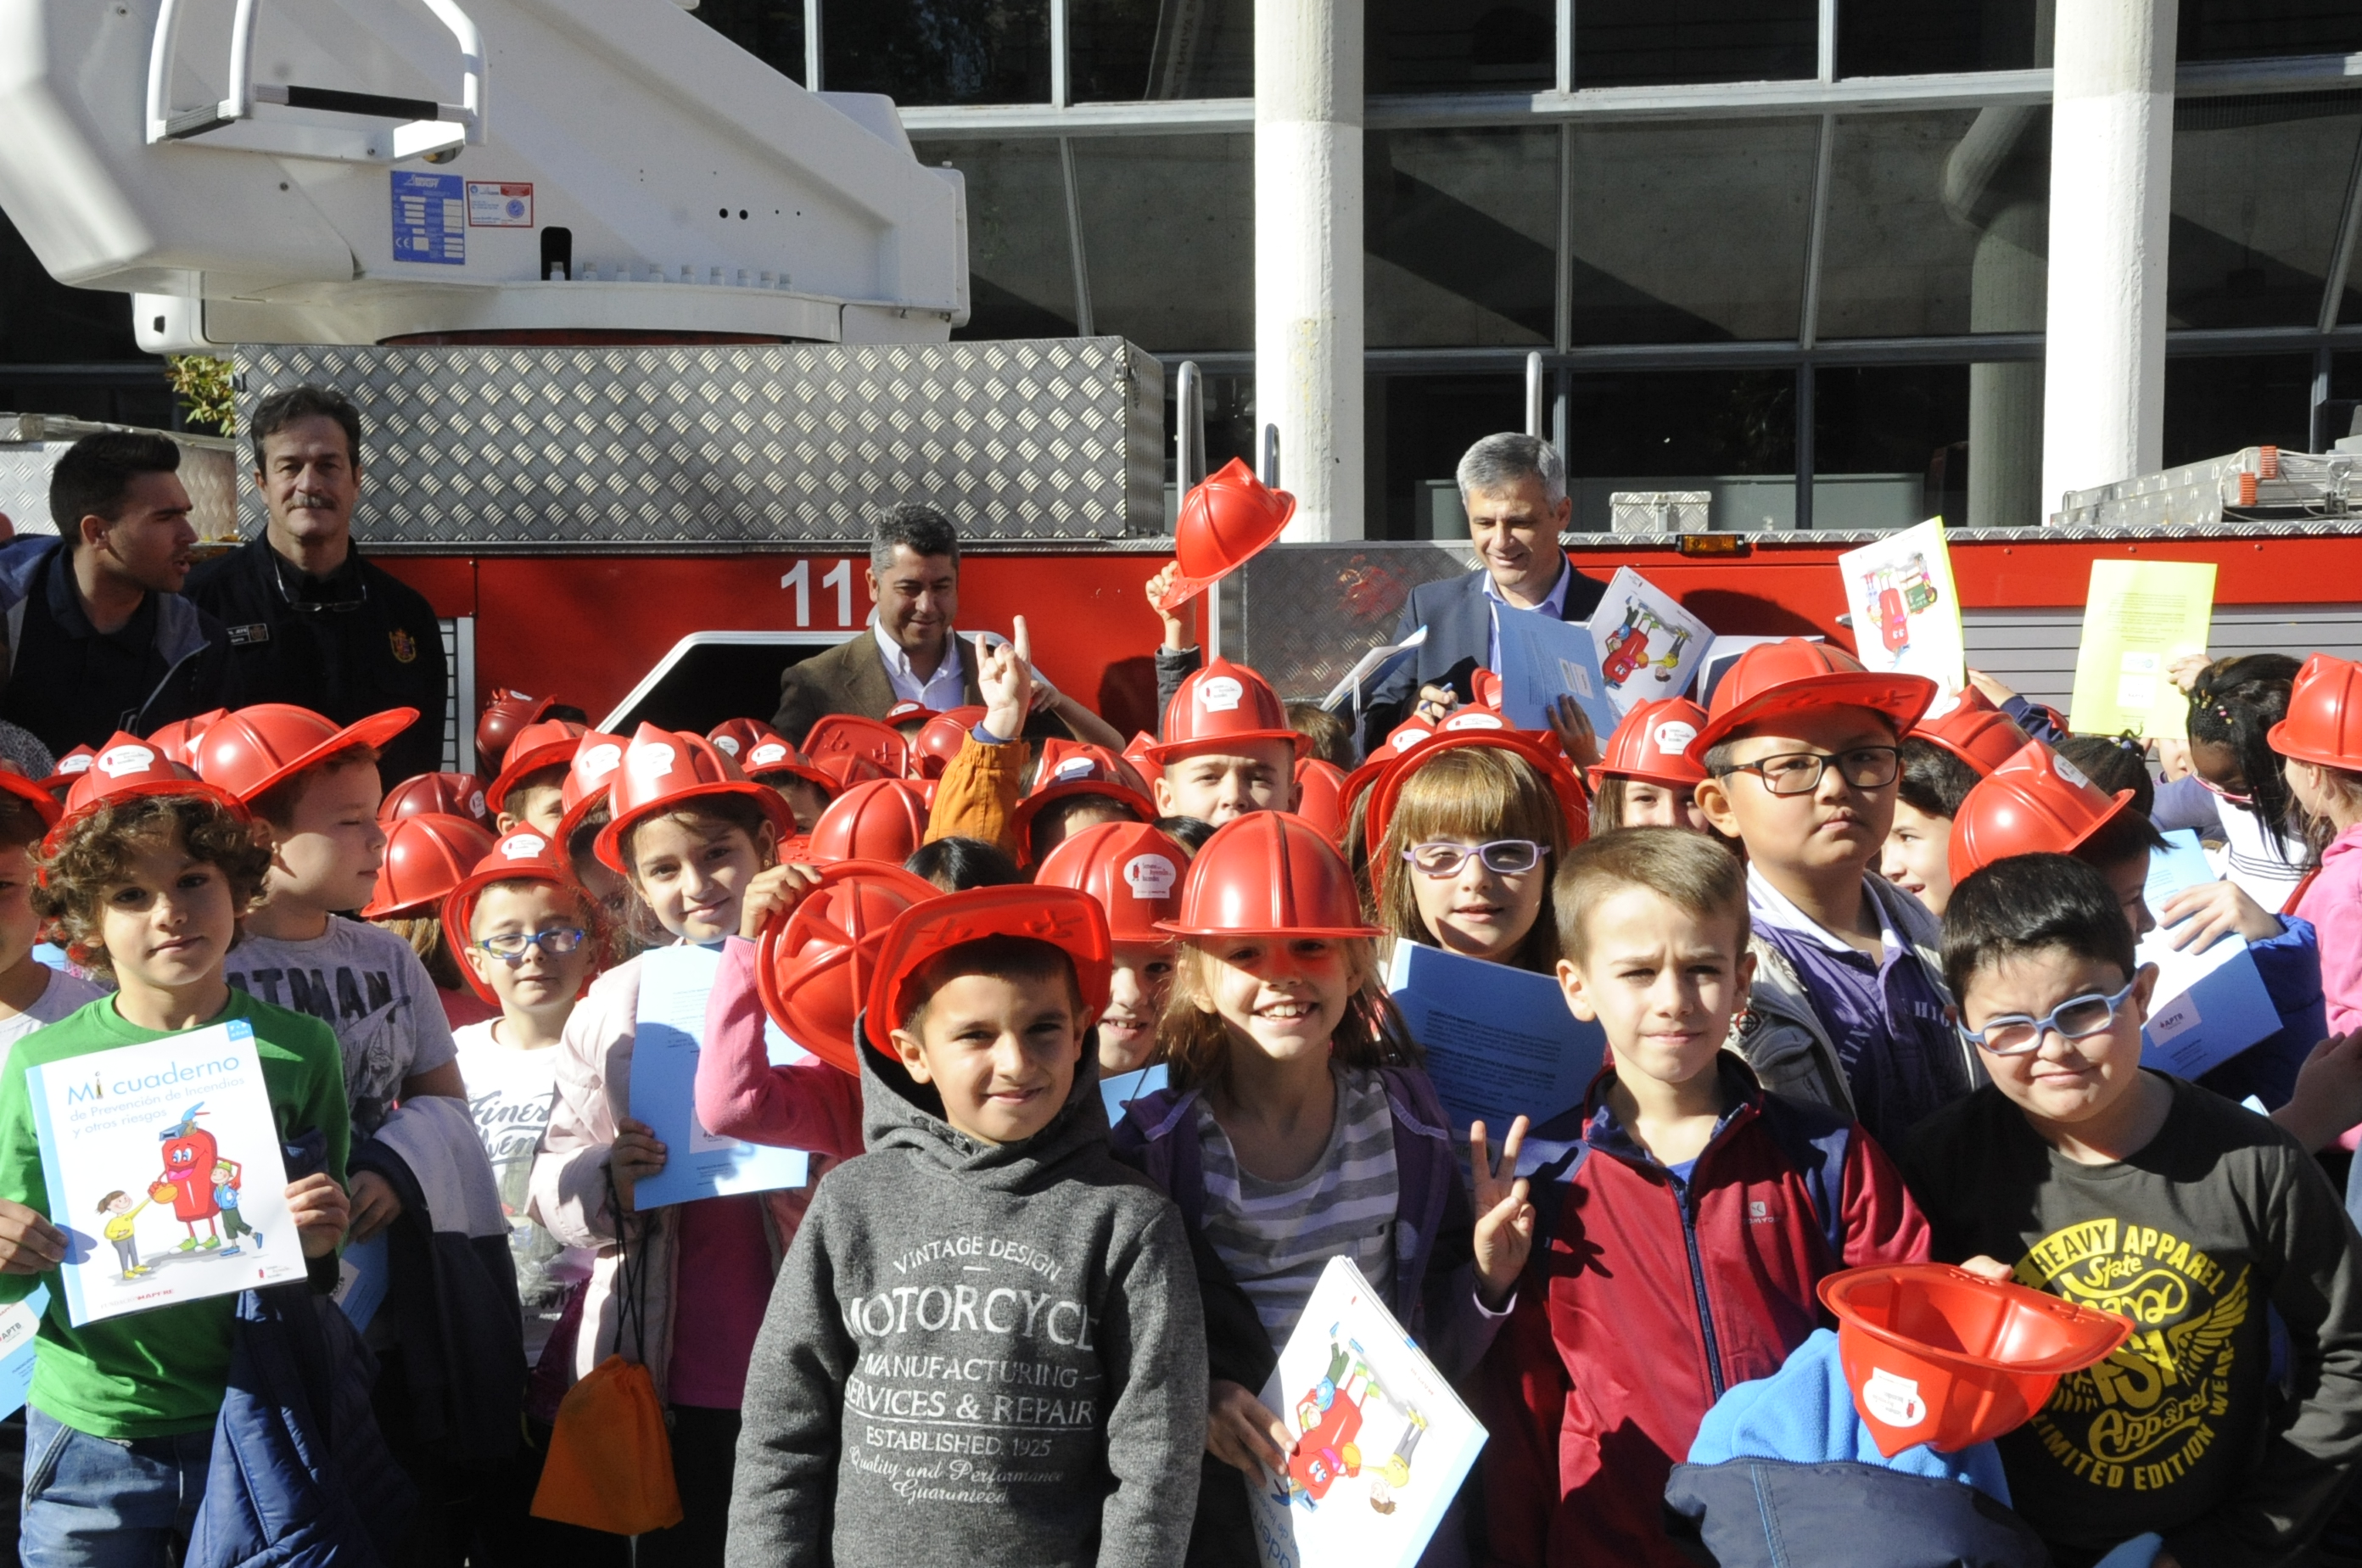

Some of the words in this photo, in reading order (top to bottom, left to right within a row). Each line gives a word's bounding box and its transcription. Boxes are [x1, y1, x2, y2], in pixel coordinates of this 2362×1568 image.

[781, 559, 879, 626] 11
[113, 1057, 239, 1095] cuaderno
[70, 1108, 87, 1123] de
[91, 1094, 161, 1117] Prevención
[165, 1089, 182, 1101] de
[185, 1076, 244, 1096] Incendios
[72, 1127, 81, 1140] y
[85, 1119, 117, 1134] otros
[121, 1108, 167, 1126] riesgos
[893, 1235, 983, 1274] VINTAGE
[988, 1237, 1062, 1282] DESIGN
[2029, 1224, 2108, 1274] HEAVY
[2122, 1224, 2225, 1296] APPAREL
[2083, 1253, 2143, 1289] State
[1, 1322, 22, 1341] APTB
[841, 1284, 1096, 1352] MOTORCYCL
[864, 1352, 1078, 1388] MANUFACTURING
[844, 1374, 947, 1418] SERVICES
[956, 1393, 982, 1420] &
[991, 1394, 1095, 1425] REPAIR
[2089, 1376, 2210, 1463] Apparel
[848, 1445, 900, 1481] Quality
[905, 1460, 943, 1480] and
[949, 1459, 1064, 1489] Performance
[1012, 1438, 1052, 1458] 1925
[2133, 1423, 2215, 1491] EDITION
[893, 1478, 1009, 1505] Guaranteed
